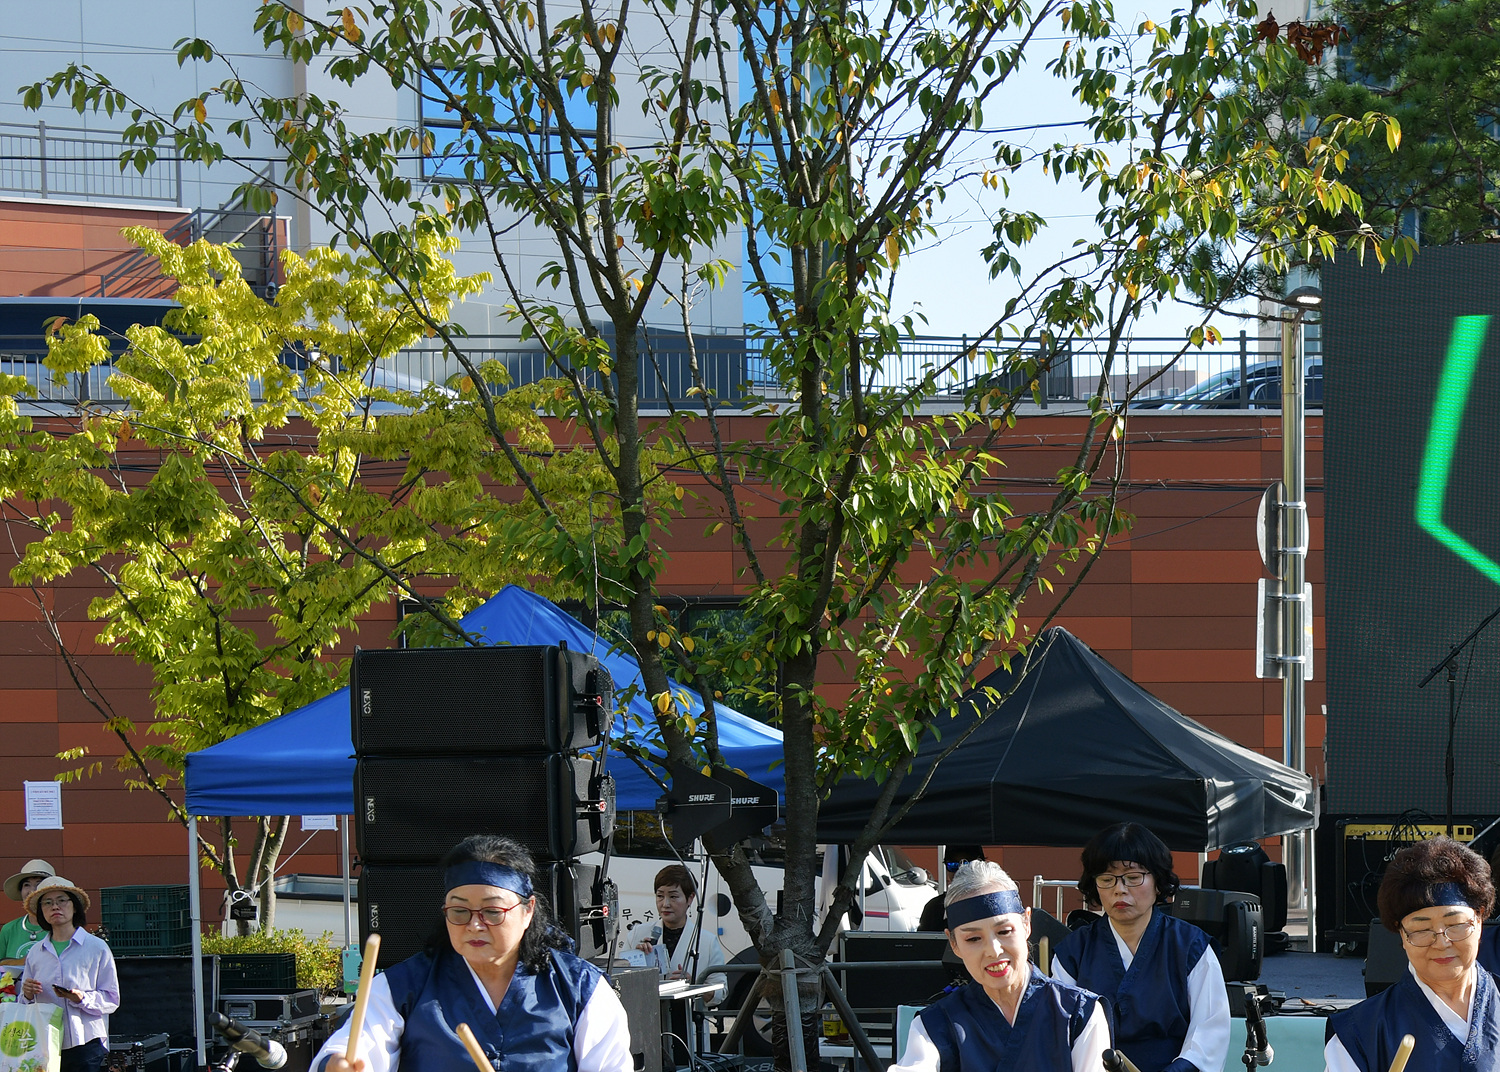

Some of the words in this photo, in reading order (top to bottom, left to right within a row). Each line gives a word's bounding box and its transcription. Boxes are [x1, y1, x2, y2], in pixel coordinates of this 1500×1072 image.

[363, 690, 371, 714] NEXO
[688, 793, 716, 802] SHURE
[730, 796, 760, 804] SHURE
[367, 798, 375, 822] NEXO
[370, 904, 379, 928] NEXO
